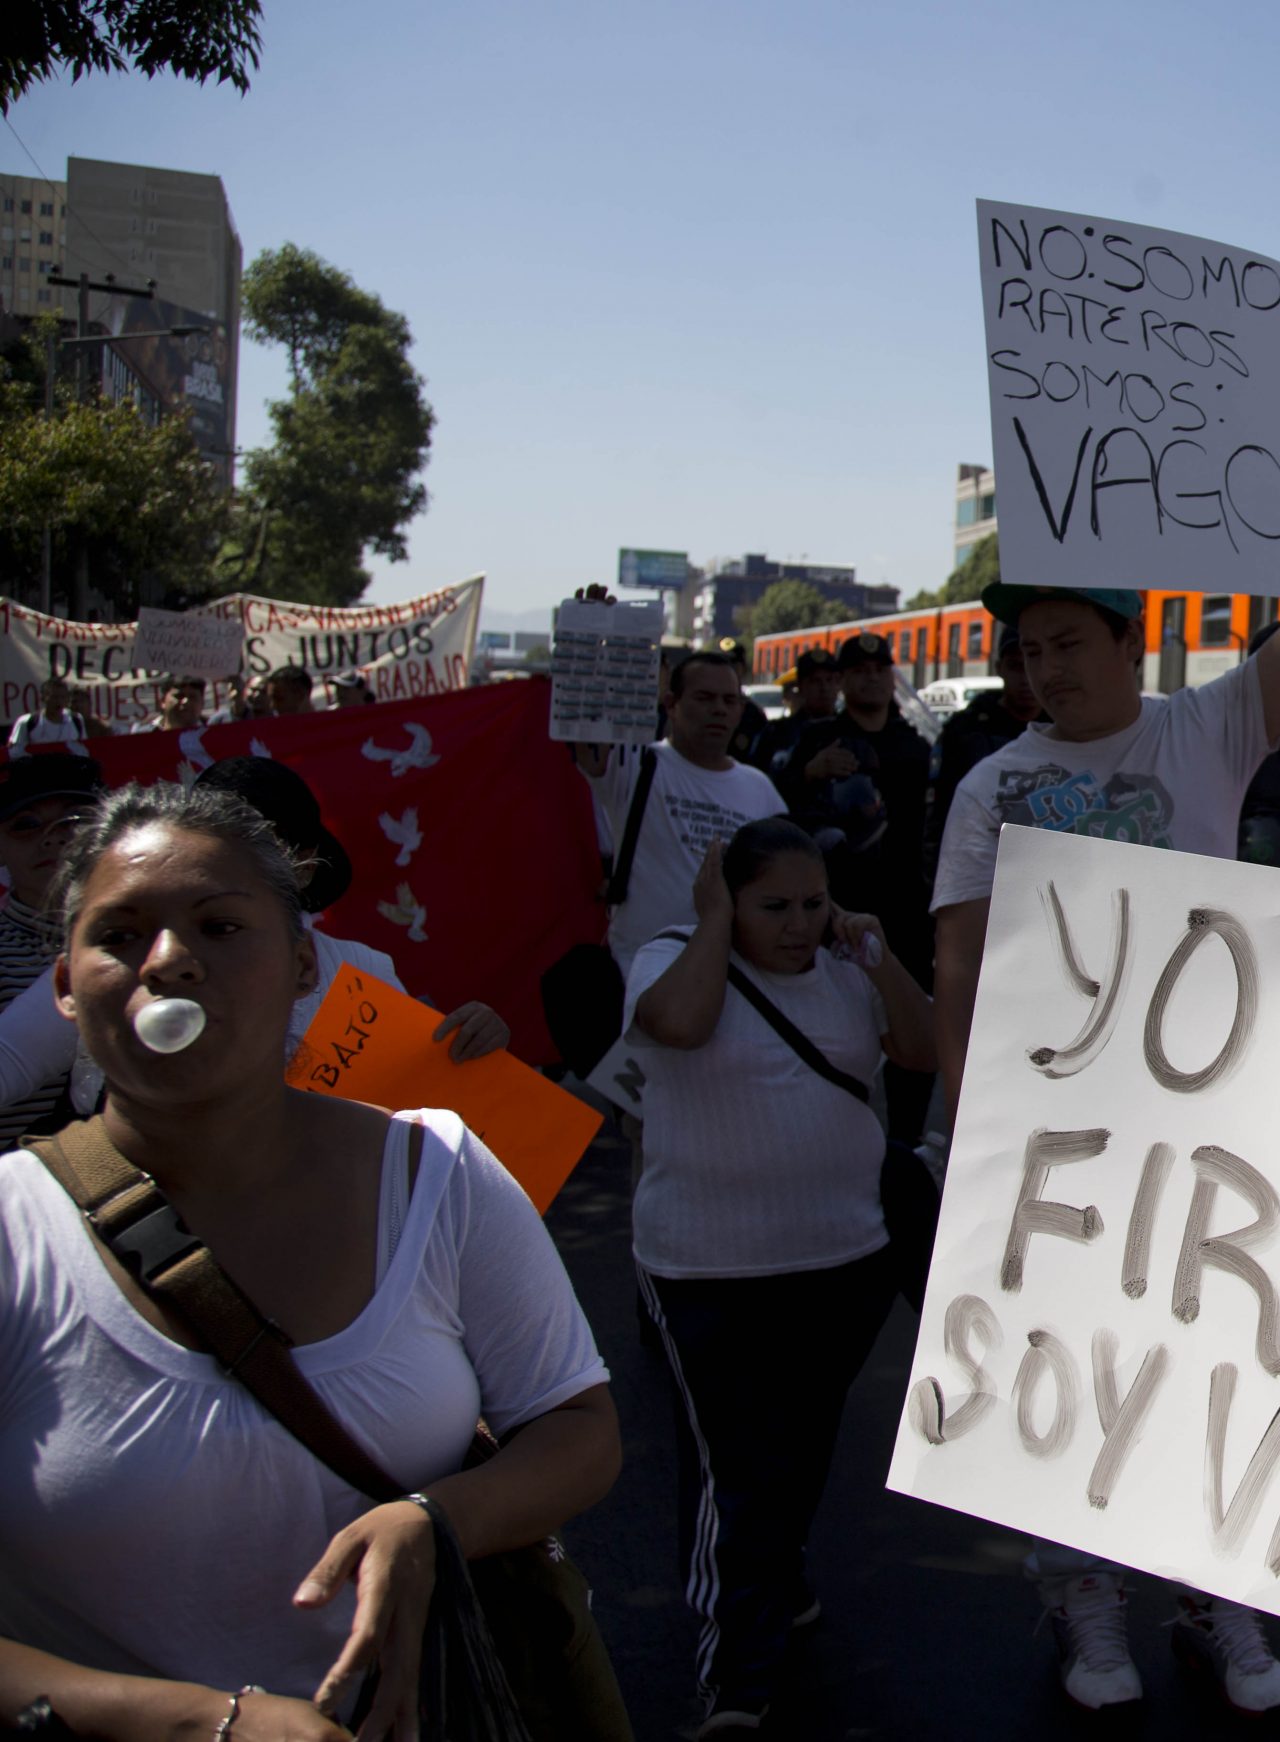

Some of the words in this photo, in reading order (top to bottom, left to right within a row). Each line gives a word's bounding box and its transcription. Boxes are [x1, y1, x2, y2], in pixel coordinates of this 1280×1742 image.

[999, 278, 1249, 377] RATEROS
[288, 622, 433, 671] JUNTOS
[1024, 878, 1262, 1096] YO
[909, 1294, 1173, 1511] SOY
